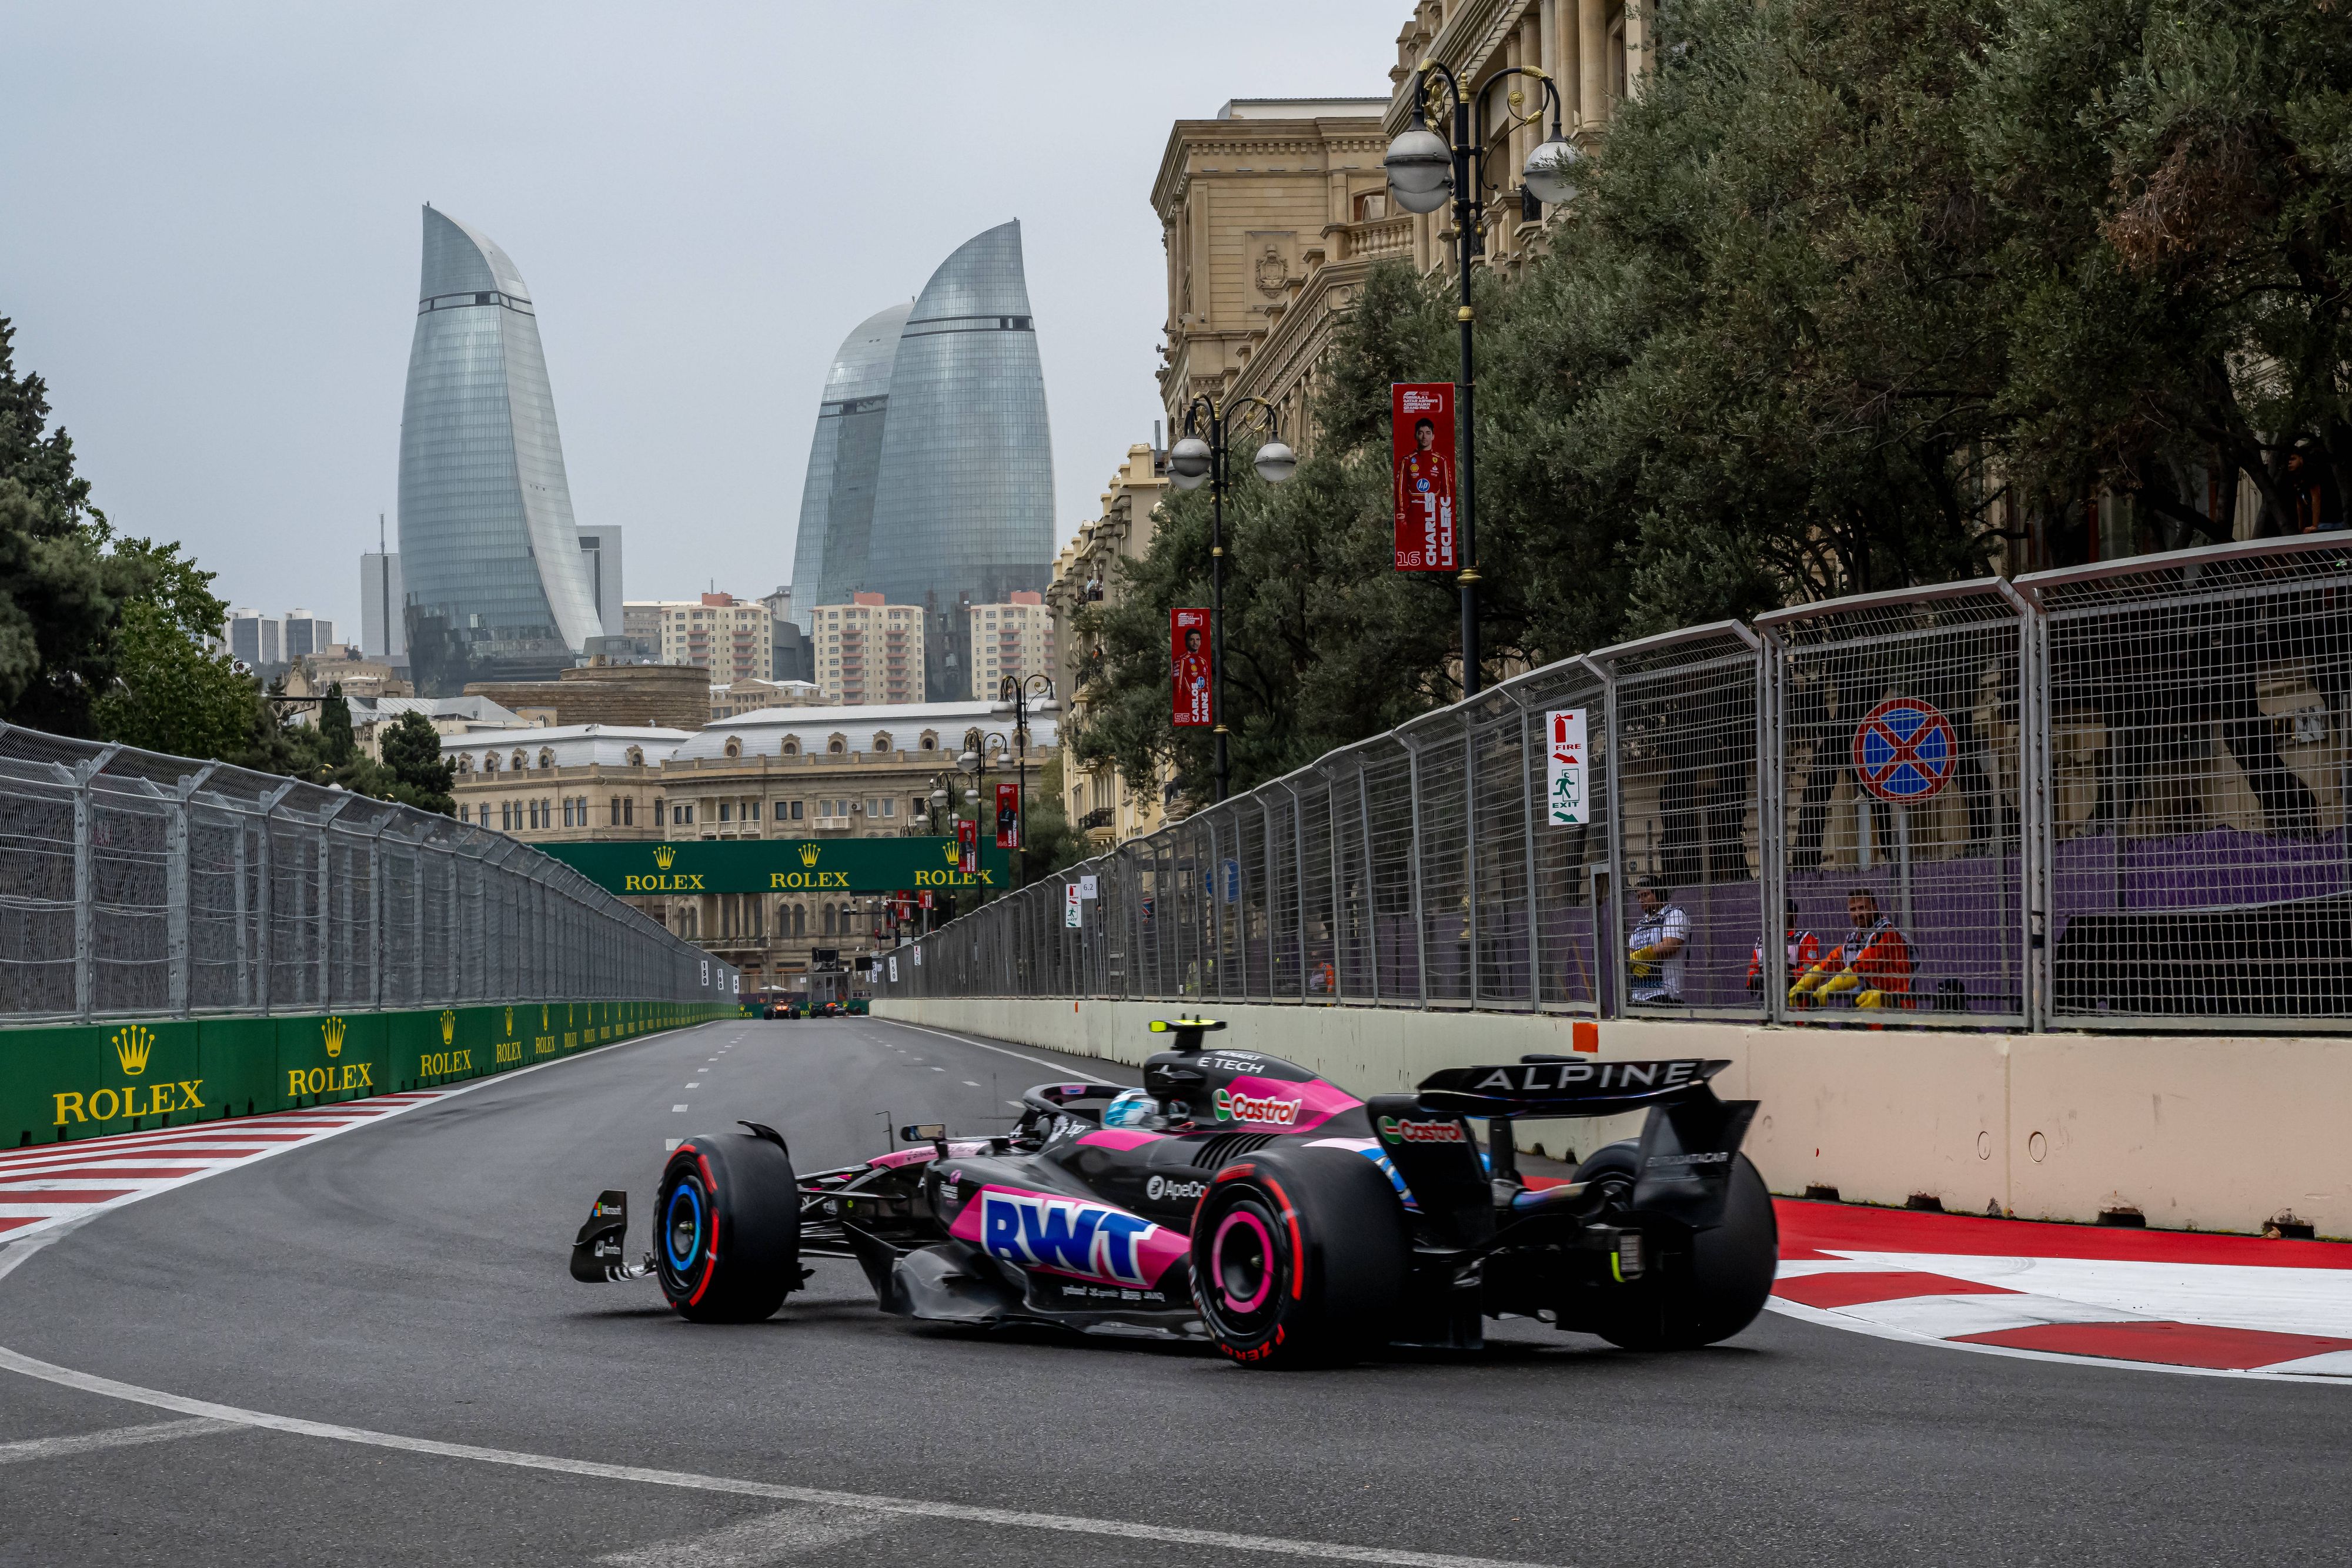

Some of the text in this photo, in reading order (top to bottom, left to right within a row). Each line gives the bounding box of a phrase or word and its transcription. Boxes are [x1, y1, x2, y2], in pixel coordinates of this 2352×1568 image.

[1424, 492, 1436, 566] CHARLES
[1440, 497, 1452, 566] LECLERC
[1397, 551, 1421, 566] 16
[1191, 683, 1200, 723] CARLOS
[1174, 713, 1190, 723] 55
[625, 874, 705, 890] ROLEX
[770, 872, 850, 888] ROLEX
[914, 870, 994, 885] ROLEX
[734, 979, 738, 989] 50
[536, 1036, 555, 1054] ROLEX
[564, 1032, 577, 1048] ROLEX
[496, 1041, 522, 1063] ROLEX
[1215, 1051, 1263, 1061] RENAULT
[420, 1049, 472, 1076] ROLEX
[1197, 1057, 1265, 1074] E TECH
[288, 1063, 373, 1096] ROLEX
[1474, 1062, 1697, 1090] ALPINE
[53, 1079, 205, 1125] ROLEX
[1232, 1094, 1301, 1124] Castrol
[1065, 1121, 1087, 1138] bp
[1399, 1119, 1465, 1142] Castrol
[1164, 1180, 1210, 1200] ApeCo
[981, 1190, 1159, 1285] BWT
[1221, 1340, 1272, 1361] ZERO
